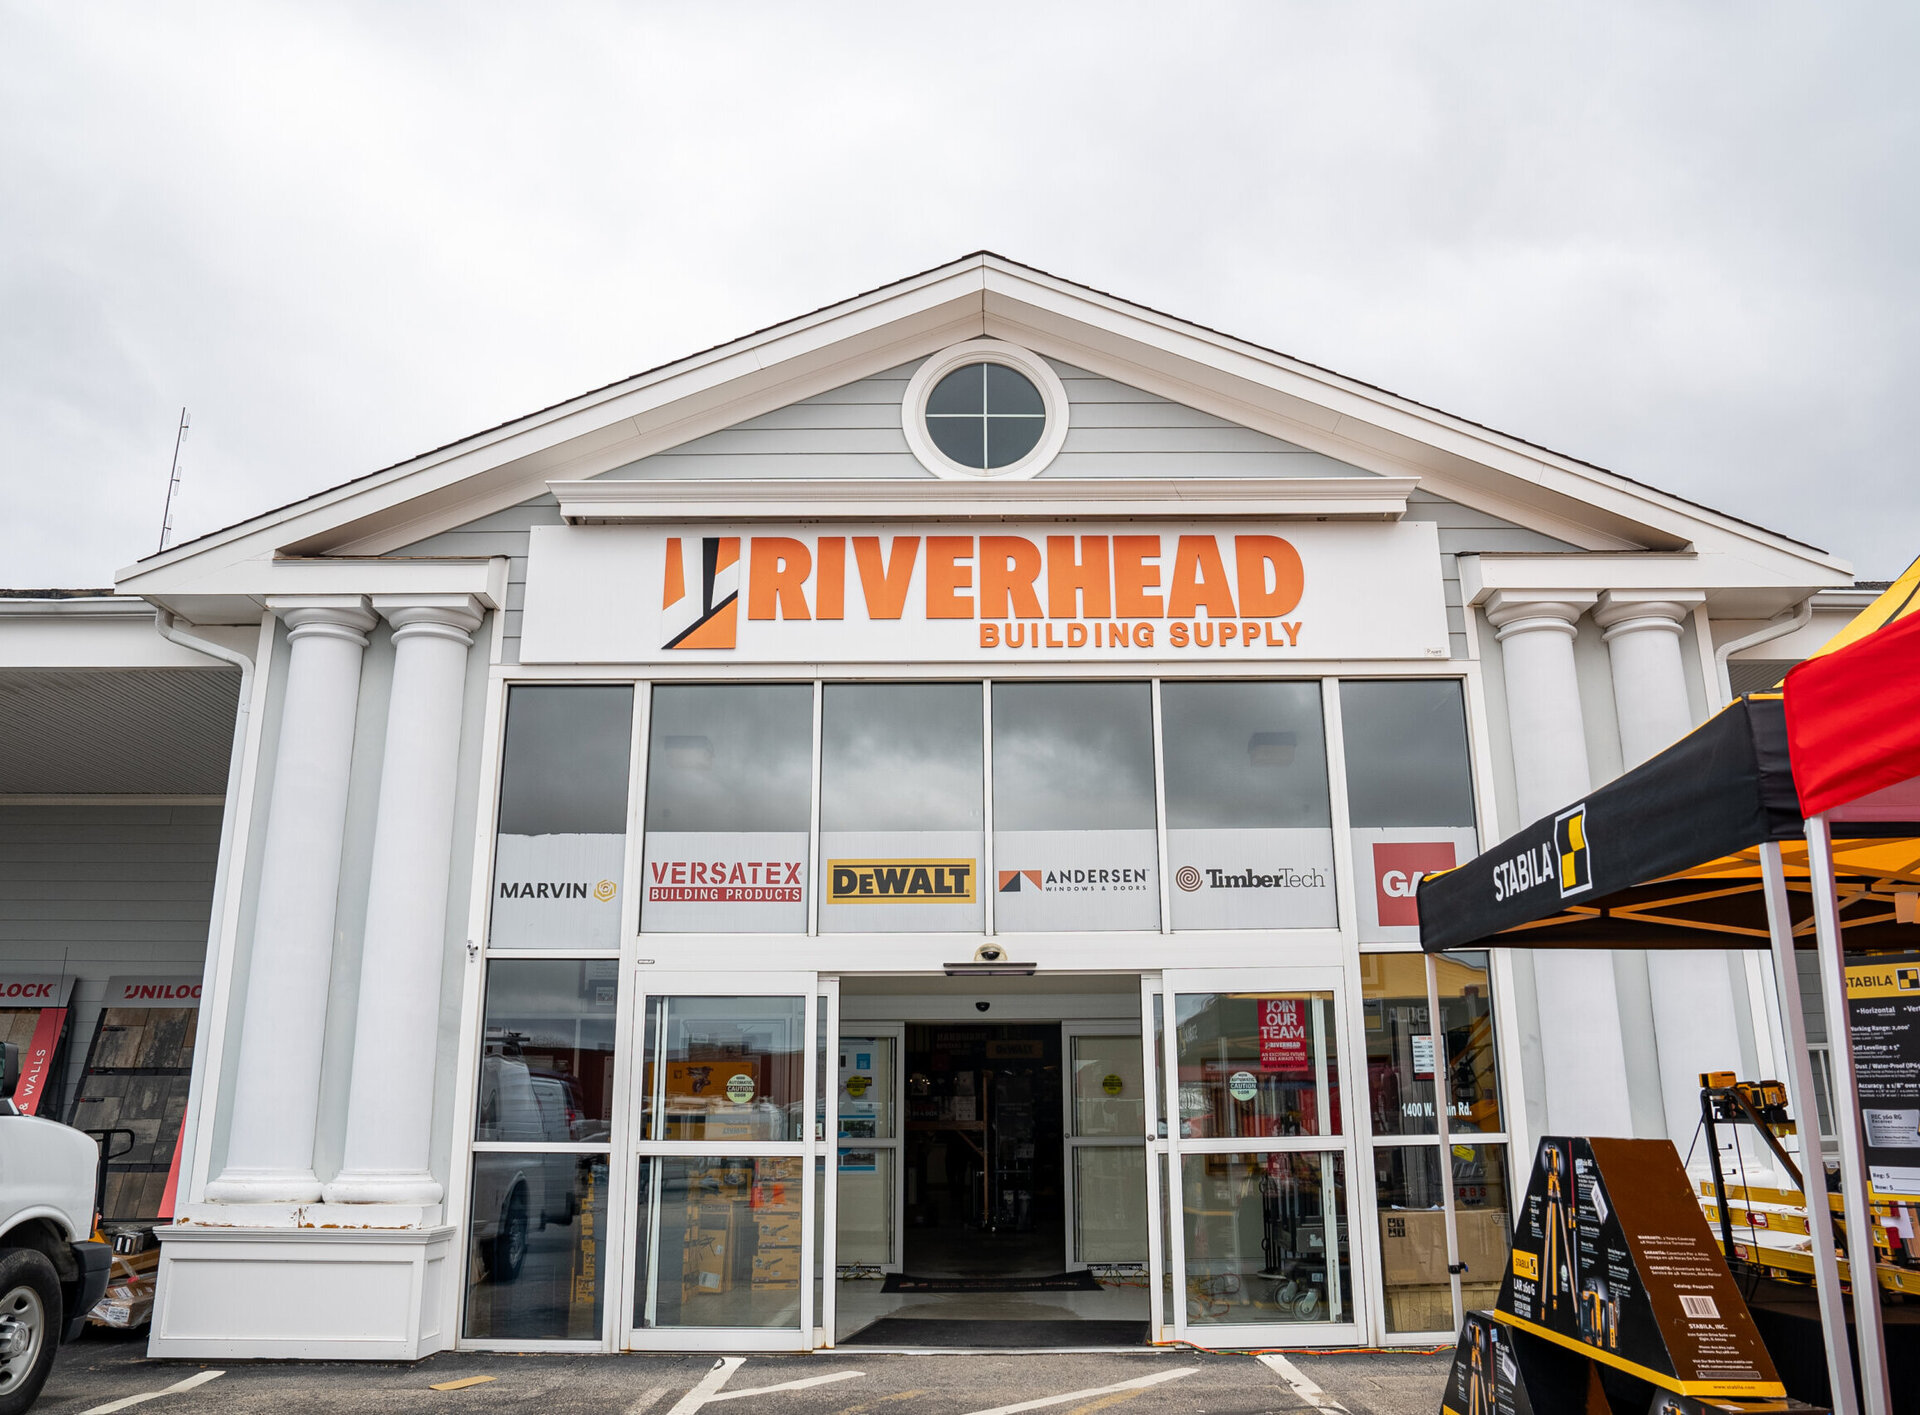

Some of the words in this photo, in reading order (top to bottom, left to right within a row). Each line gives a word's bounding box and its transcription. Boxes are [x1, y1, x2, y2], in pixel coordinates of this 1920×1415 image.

[748, 534, 1305, 621] RIVERHEAD
[979, 622, 1155, 648] BUILDING
[1169, 621, 1303, 648] SUPPLY
[650, 861, 801, 886] VERSATEX
[1046, 868, 1147, 884] ANDERSEN
[1206, 867, 1326, 889] TimberTech
[1493, 842, 1554, 902] STABILA
[500, 881, 588, 899] MARVIN
[651, 888, 721, 901] BUILDING
[726, 887, 800, 901] PRODUCTS
[0, 983, 54, 998] LOCK
[124, 984, 203, 999] UNILOC
[1266, 1000, 1296, 1013] JOIN
[1266, 1013, 1297, 1026] OUR
[1260, 1026, 1304, 1039] TEAM
[22, 1049, 46, 1097] WALLS
[1402, 1102, 1422, 1117] 1400
[1424, 1102, 1435, 1117] W.
[1458, 1101, 1472, 1117] Rd.
